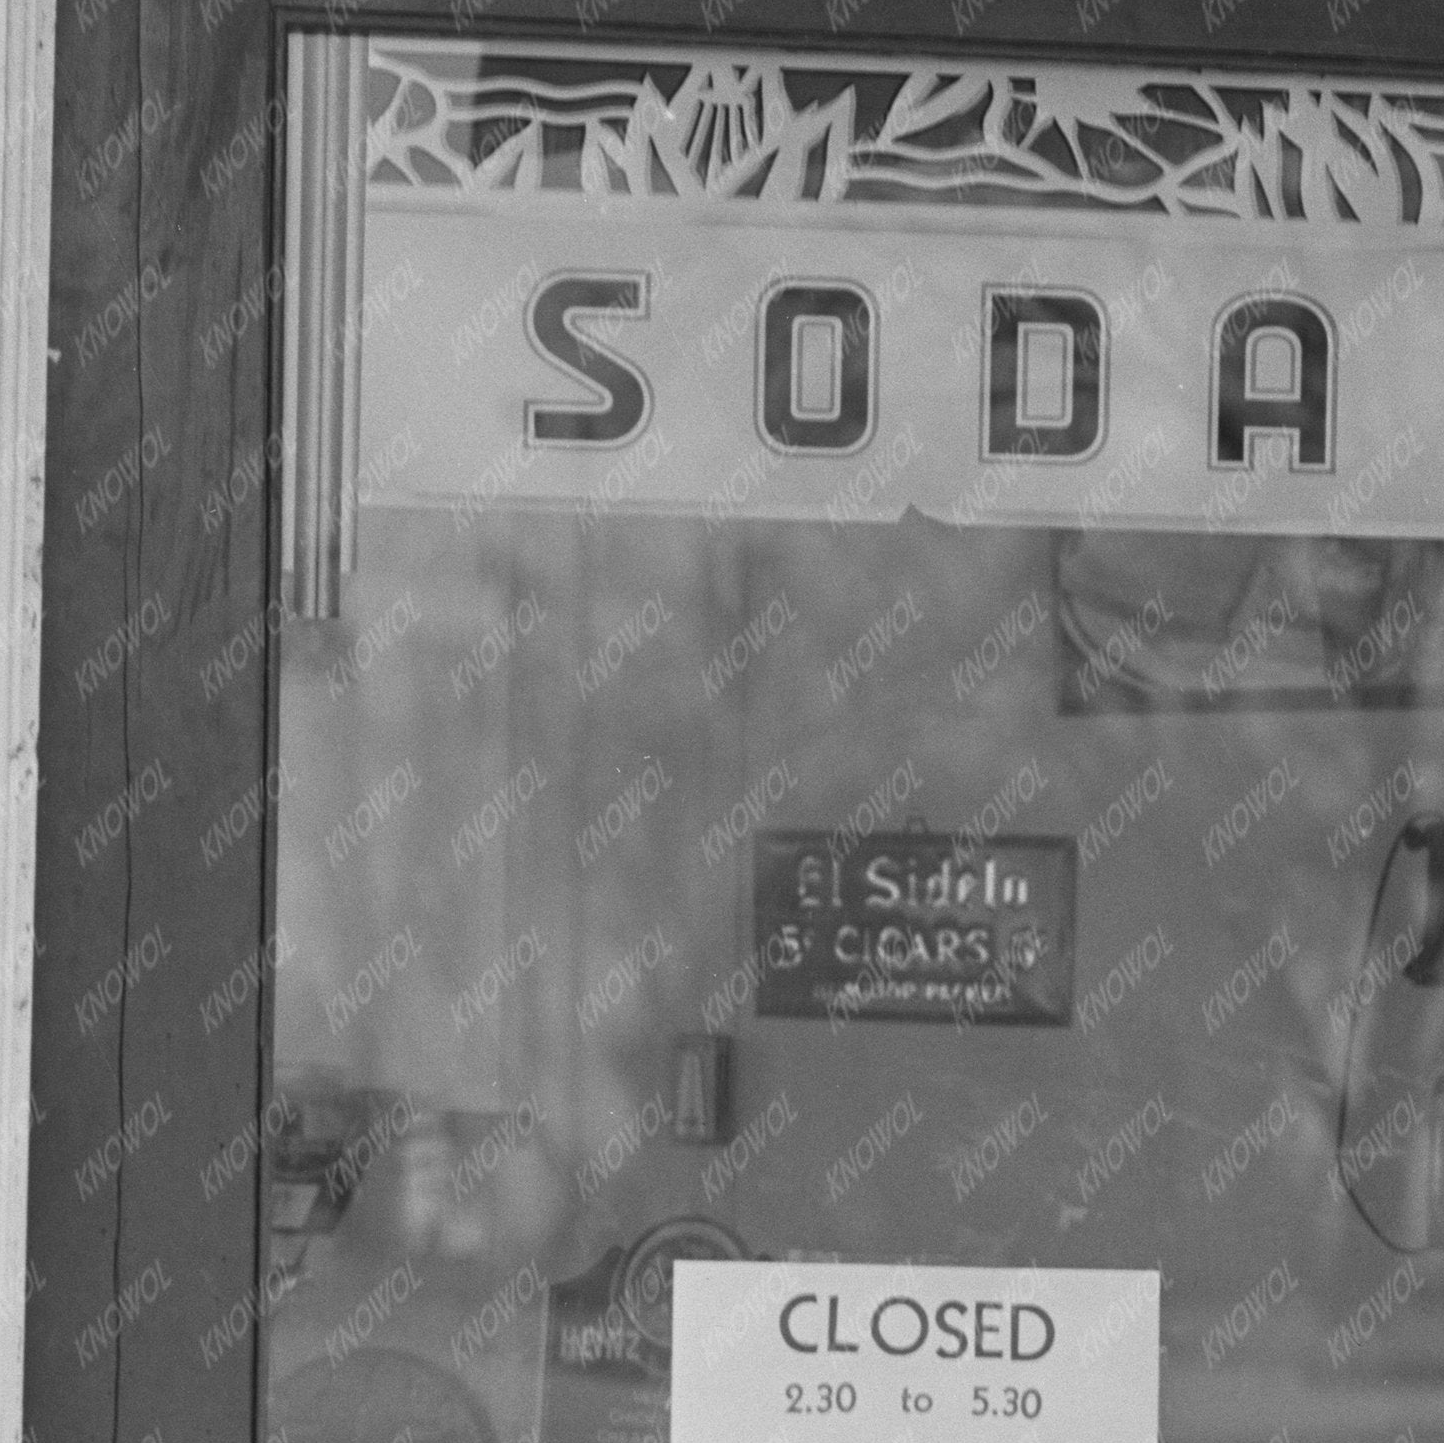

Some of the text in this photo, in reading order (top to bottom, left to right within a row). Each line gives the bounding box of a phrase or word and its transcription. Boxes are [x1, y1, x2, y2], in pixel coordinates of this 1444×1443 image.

[523, 267, 1339, 475] SODA
[833, 924, 990, 970] CIGARS
[559, 1326, 641, 1361] HEINZ
[779, 1293, 1055, 1362] CLOSED
[786, 1383, 1042, 1419] 2.30 to 5.30
